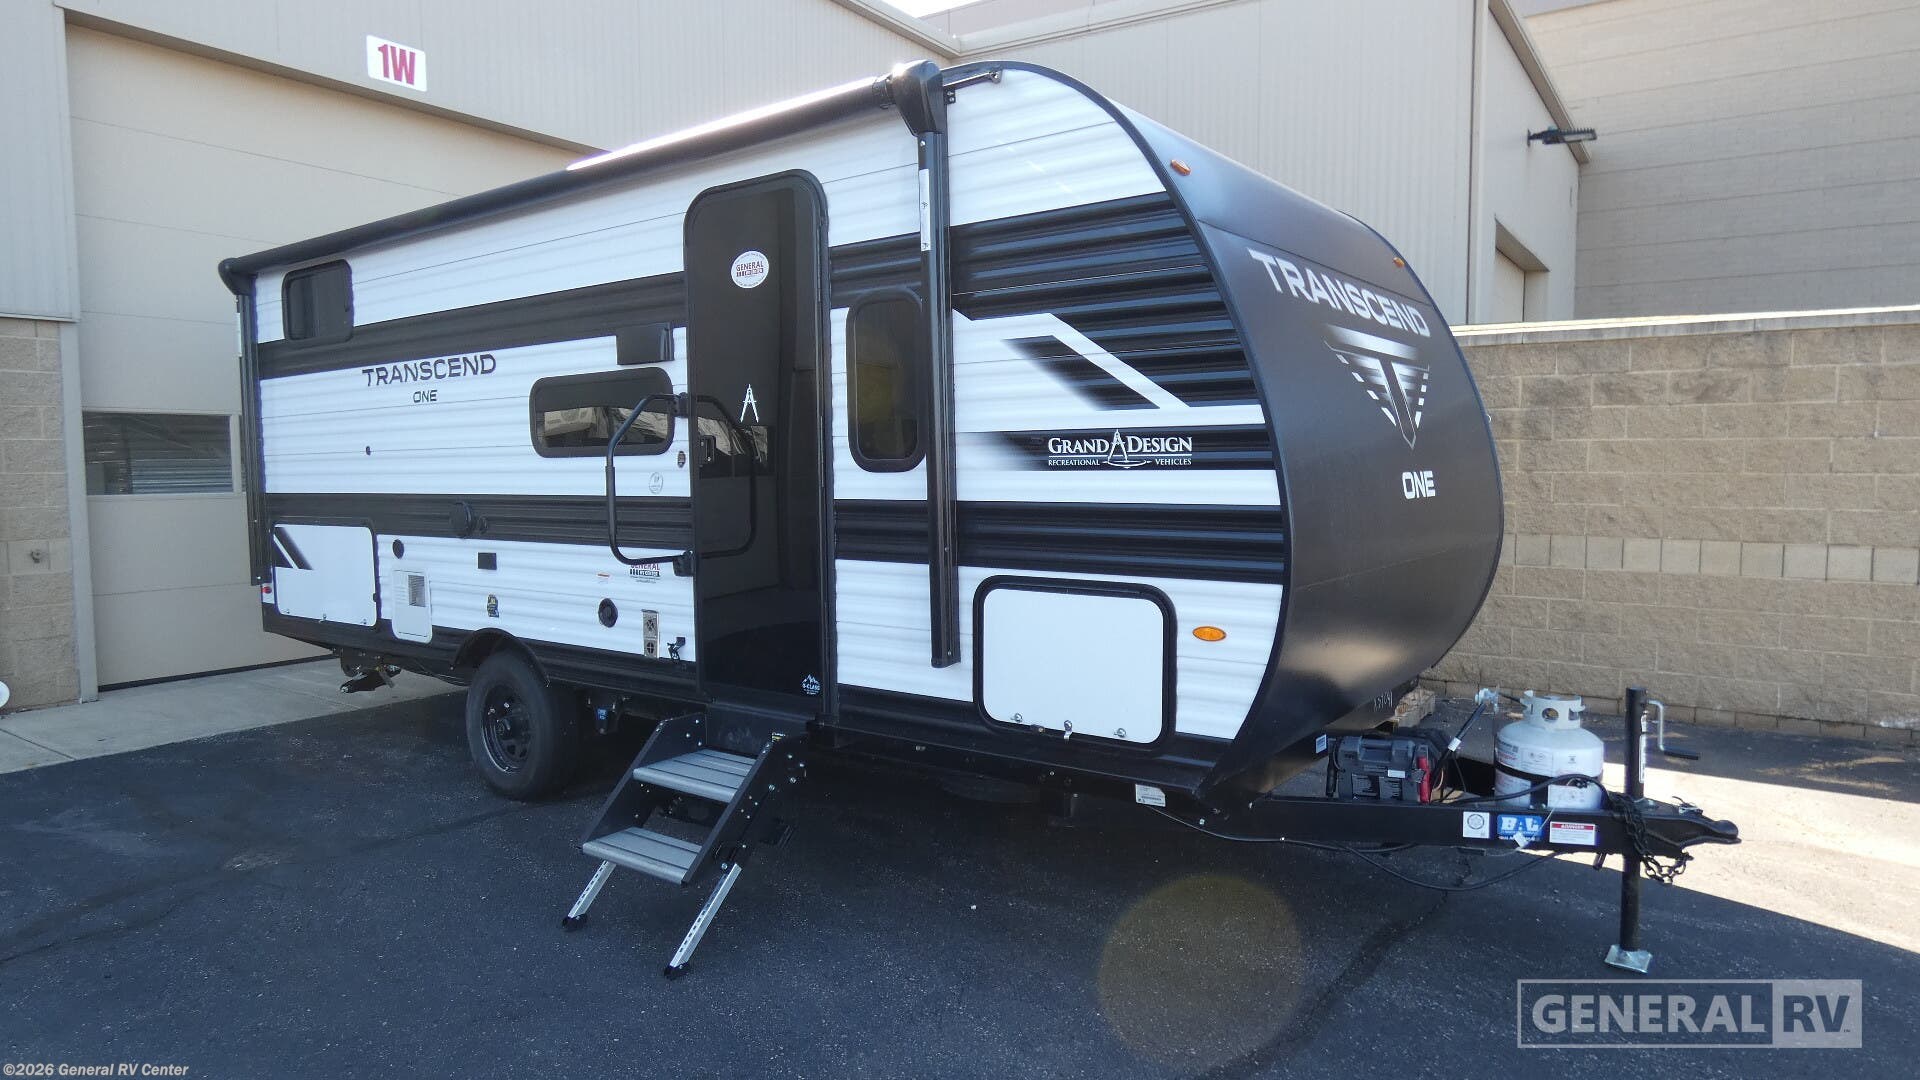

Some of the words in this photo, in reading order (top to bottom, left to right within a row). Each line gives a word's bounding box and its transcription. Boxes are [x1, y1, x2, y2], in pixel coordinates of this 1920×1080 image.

[378, 44, 416, 86] 1W
[1247, 247, 1431, 338] TRANSCEND
[362, 353, 496, 387] TRANSCEND
[413, 389, 438, 404] ONE
[1048, 437, 1109, 454] GRAND
[1127, 435, 1192, 453] DESIGN
[1048, 458, 1100, 466] RECREATIONAL
[1155, 457, 1192, 466] VEHICLES
[1402, 470, 1436, 499] ONE
